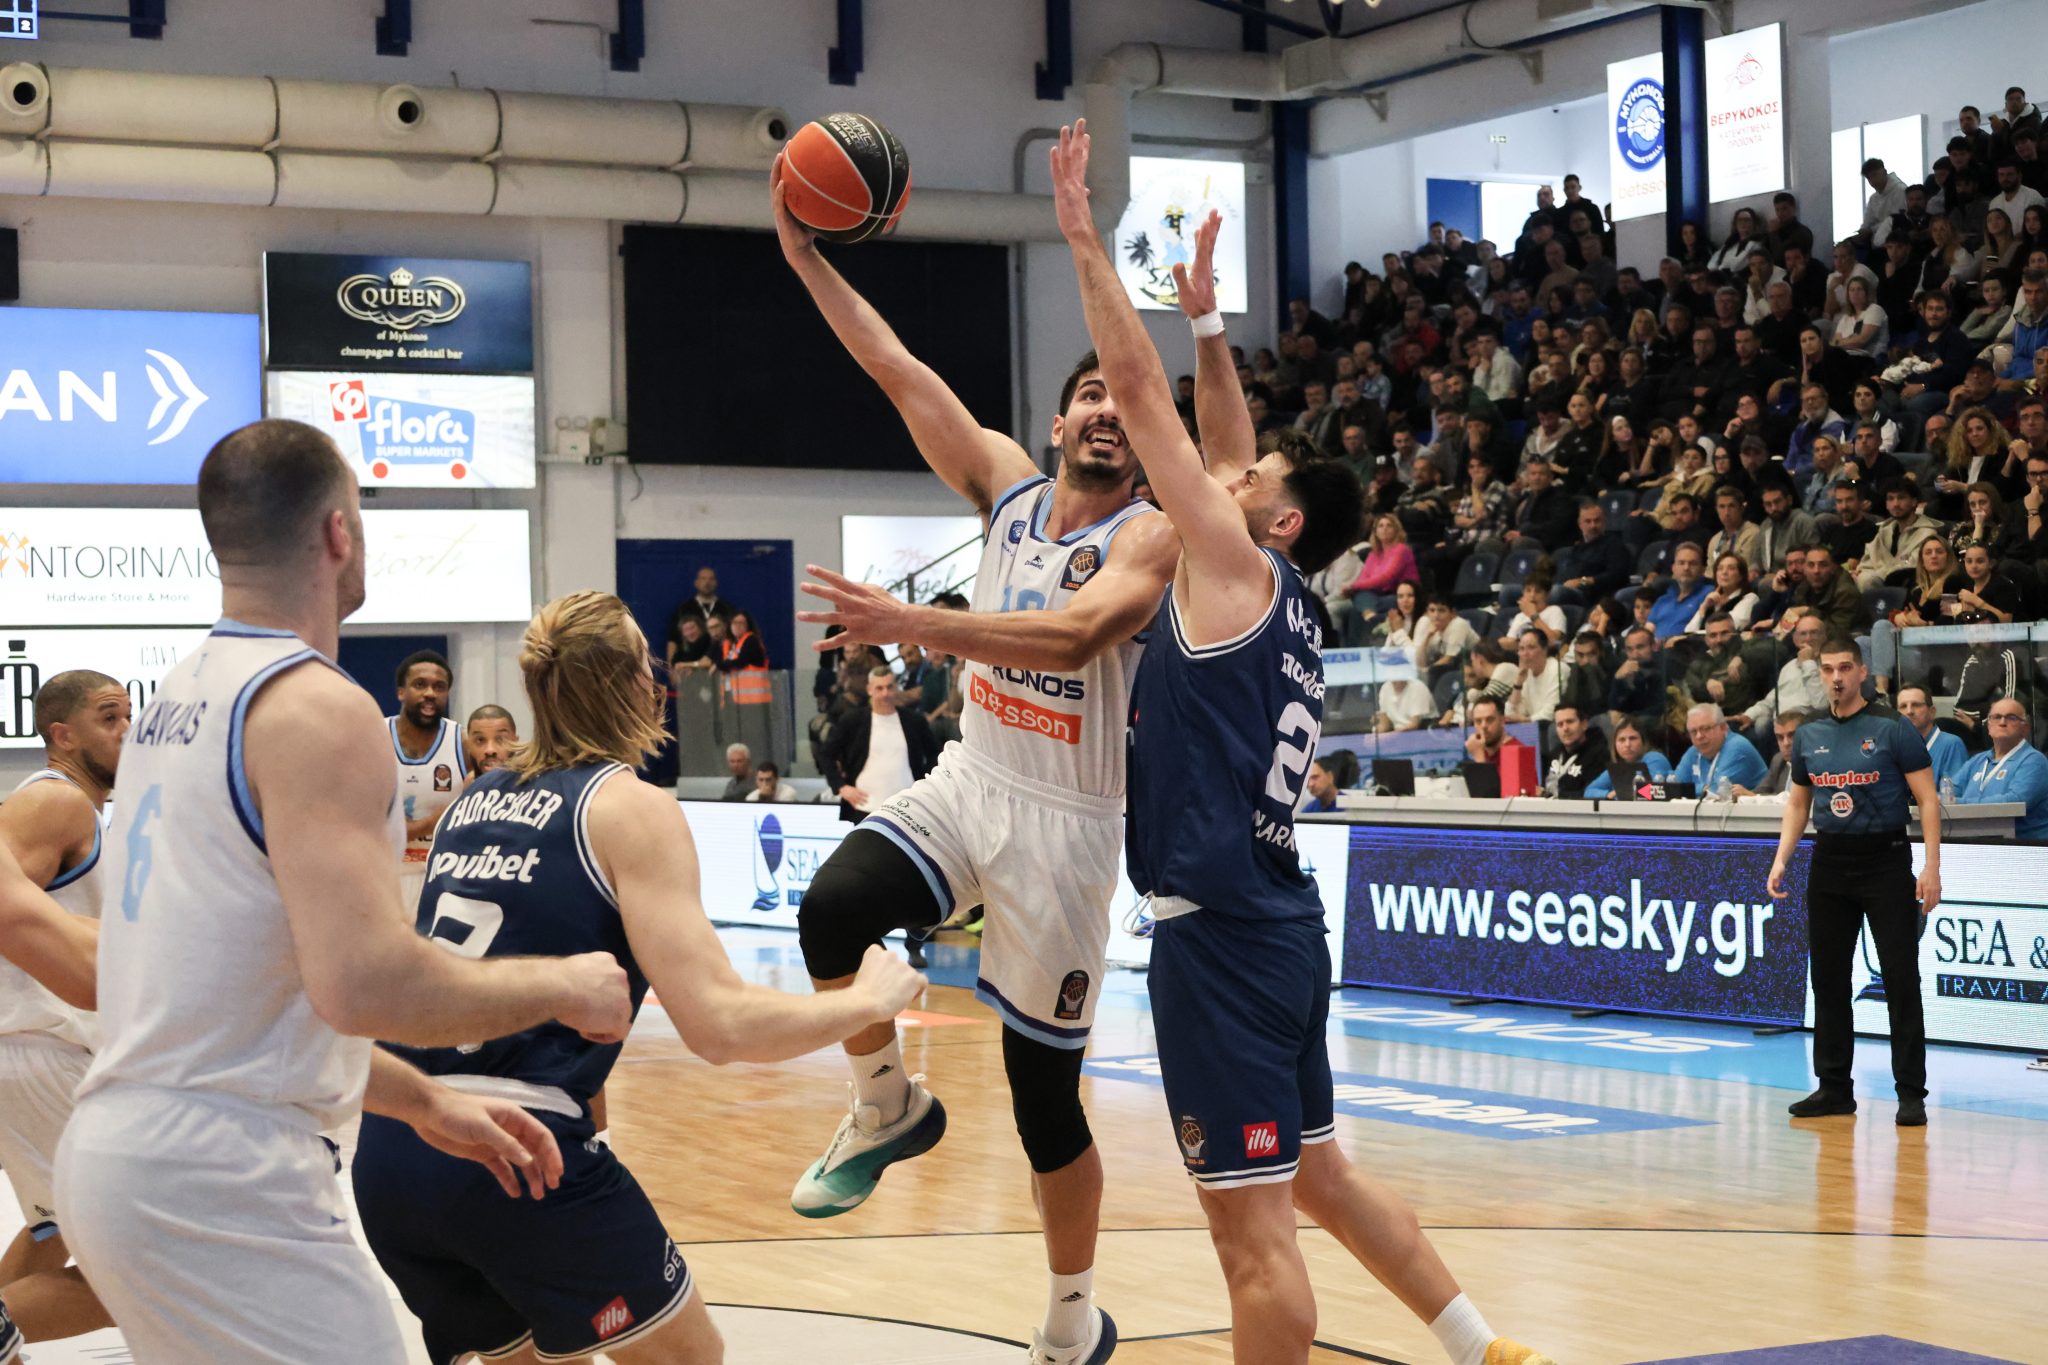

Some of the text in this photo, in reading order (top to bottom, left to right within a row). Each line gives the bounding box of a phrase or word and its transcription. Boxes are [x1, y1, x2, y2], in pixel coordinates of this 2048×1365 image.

[20, 20, 31, 31] 2
[1620, 83, 1664, 120] MYKONOS
[1710, 101, 1779, 127] ΒΕΡΥΚΟΚΟΣ
[361, 287, 442, 308] QUEEN
[376, 331, 429, 343] of Mykonos
[340, 346, 463, 360] champagne & cocktail bar
[365, 400, 470, 446] flora
[375, 446, 464, 457] SUPER MARKETS
[47, 592, 190, 602] Hardware Store & More
[1809, 770, 1880, 788] Palaplast
[121, 783, 162, 922] 6
[787, 848, 820, 881] SEA
[1369, 878, 1774, 978] www.seasky.gr
[1935, 917, 2048, 969] SEA &
[1940, 976, 2030, 1001] TRAVEL
[1247, 1127, 1277, 1154] illy
[600, 1305, 628, 1335] illy
